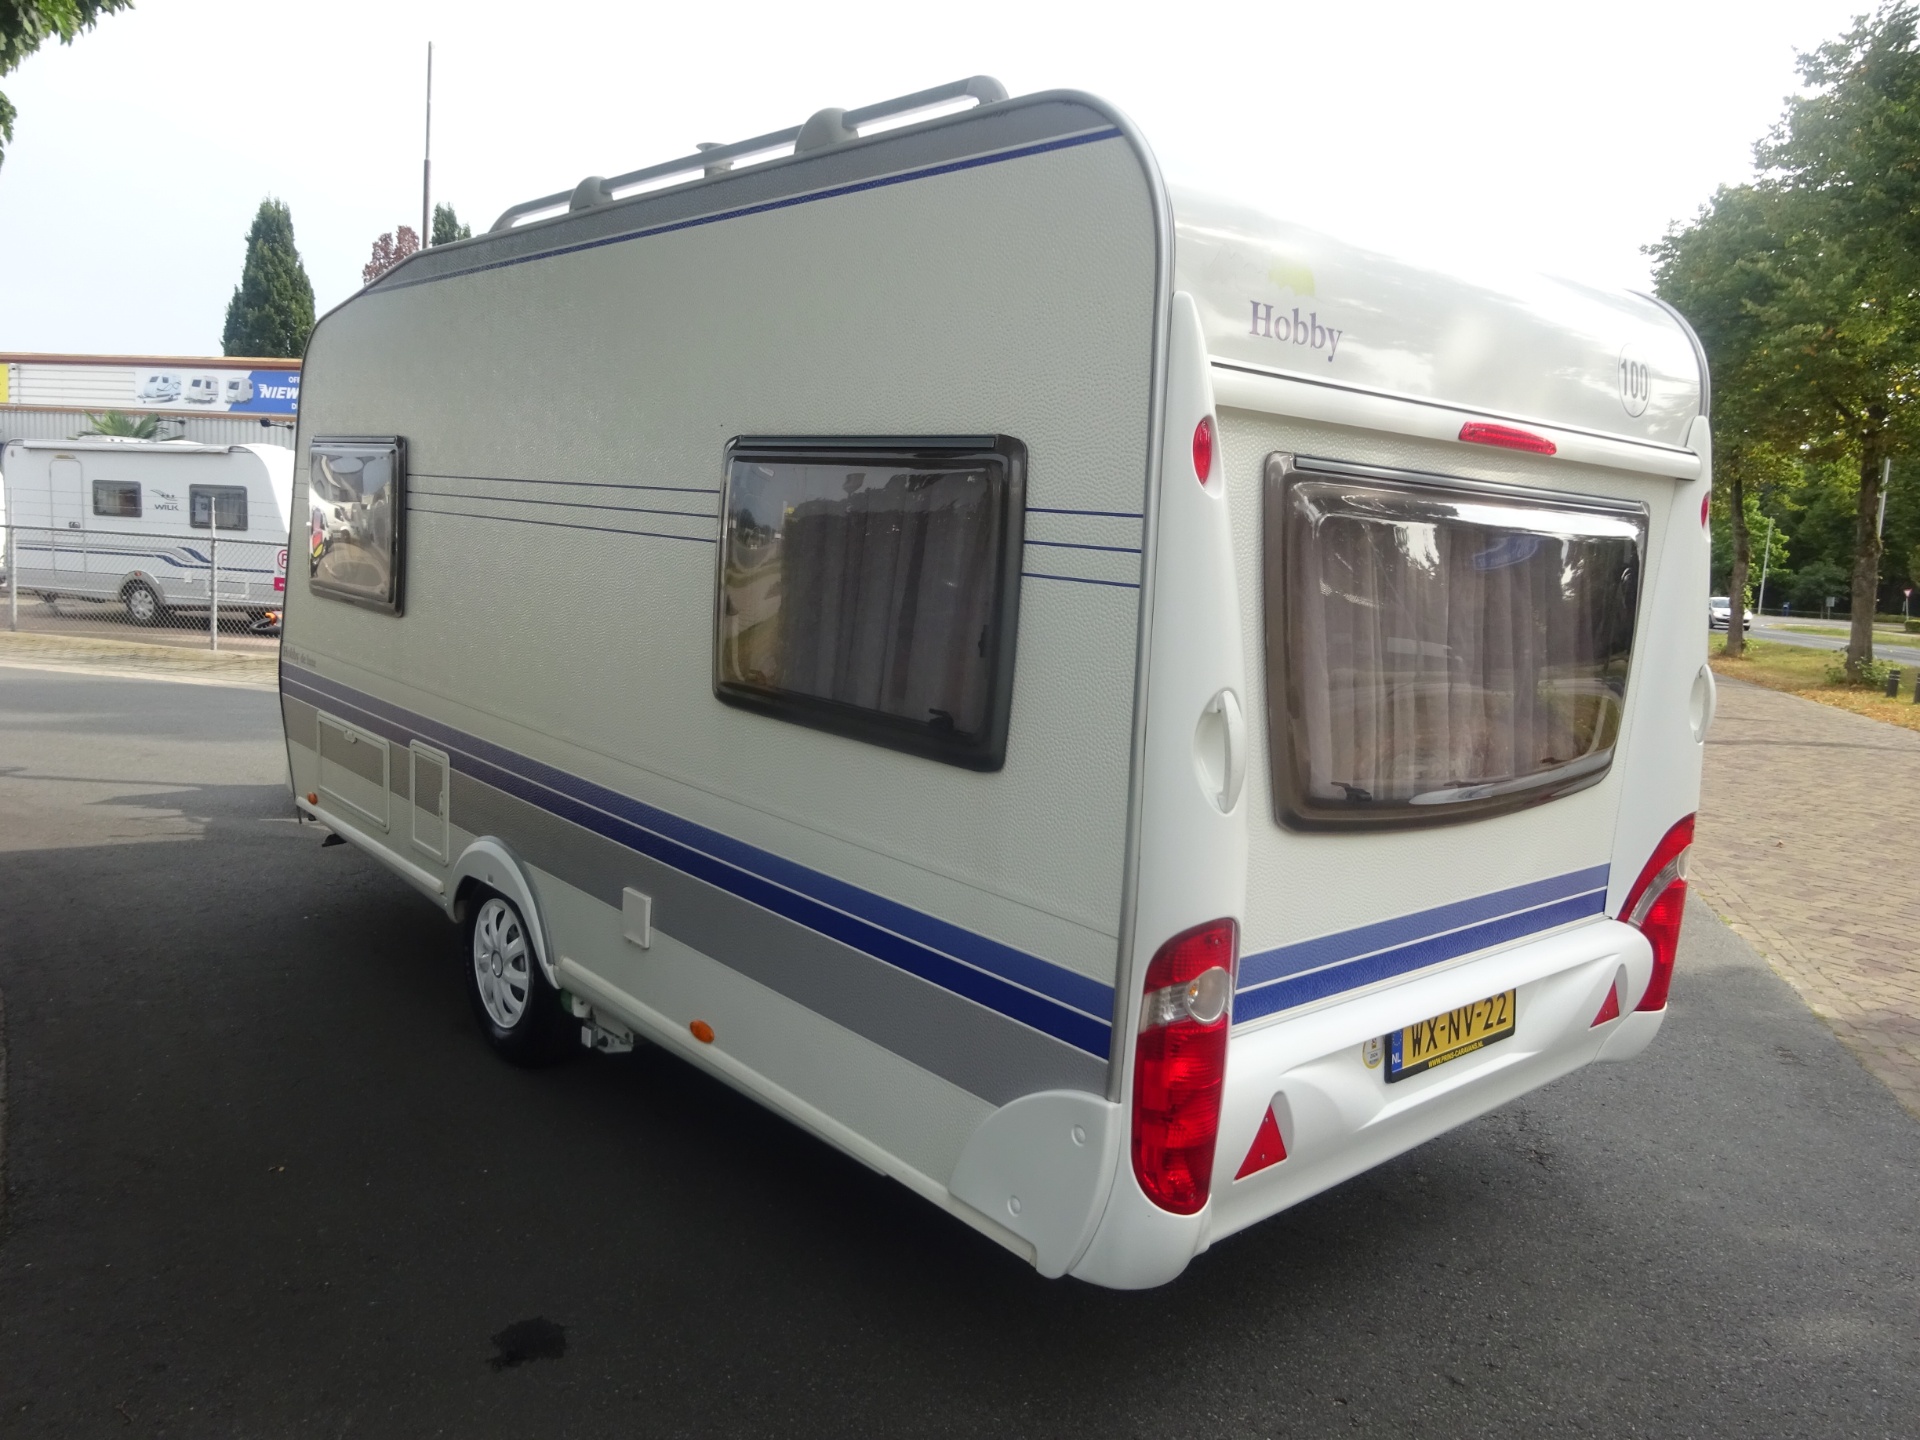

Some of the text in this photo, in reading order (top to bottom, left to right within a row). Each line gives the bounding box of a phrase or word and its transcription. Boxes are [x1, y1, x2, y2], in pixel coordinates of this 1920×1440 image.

[1249, 300, 1343, 362] Hobby
[1621, 358, 1648, 401] 100
[1411, 992, 1507, 1058] WX-NV-22
[1391, 1051, 1401, 1065] NL
